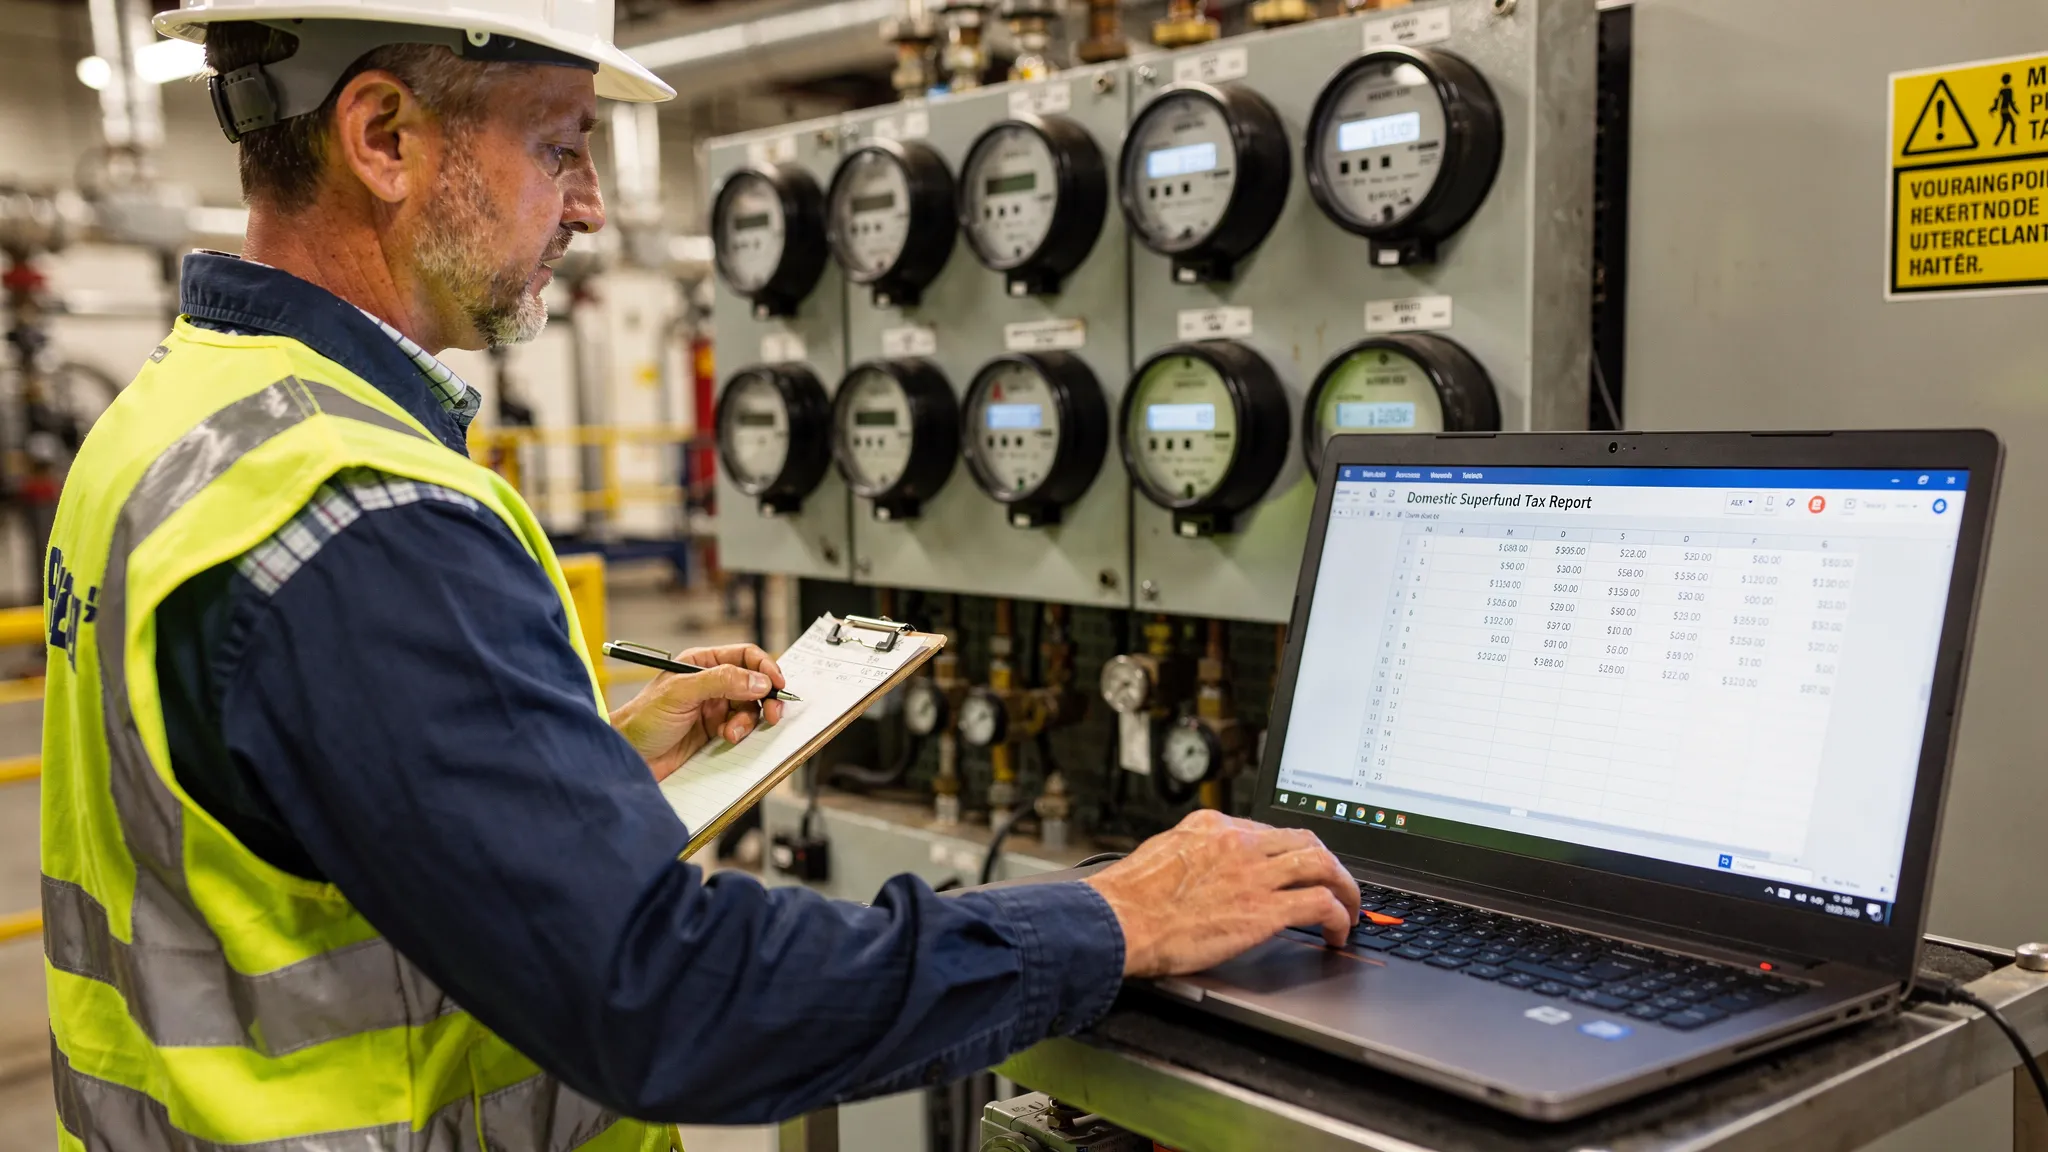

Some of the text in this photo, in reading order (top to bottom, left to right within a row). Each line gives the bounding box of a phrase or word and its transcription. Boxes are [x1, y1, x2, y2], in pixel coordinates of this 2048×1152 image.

[2030, 92, 2048, 114] P
[1407, 491, 1593, 511] Domestic Superfund Tax Report
